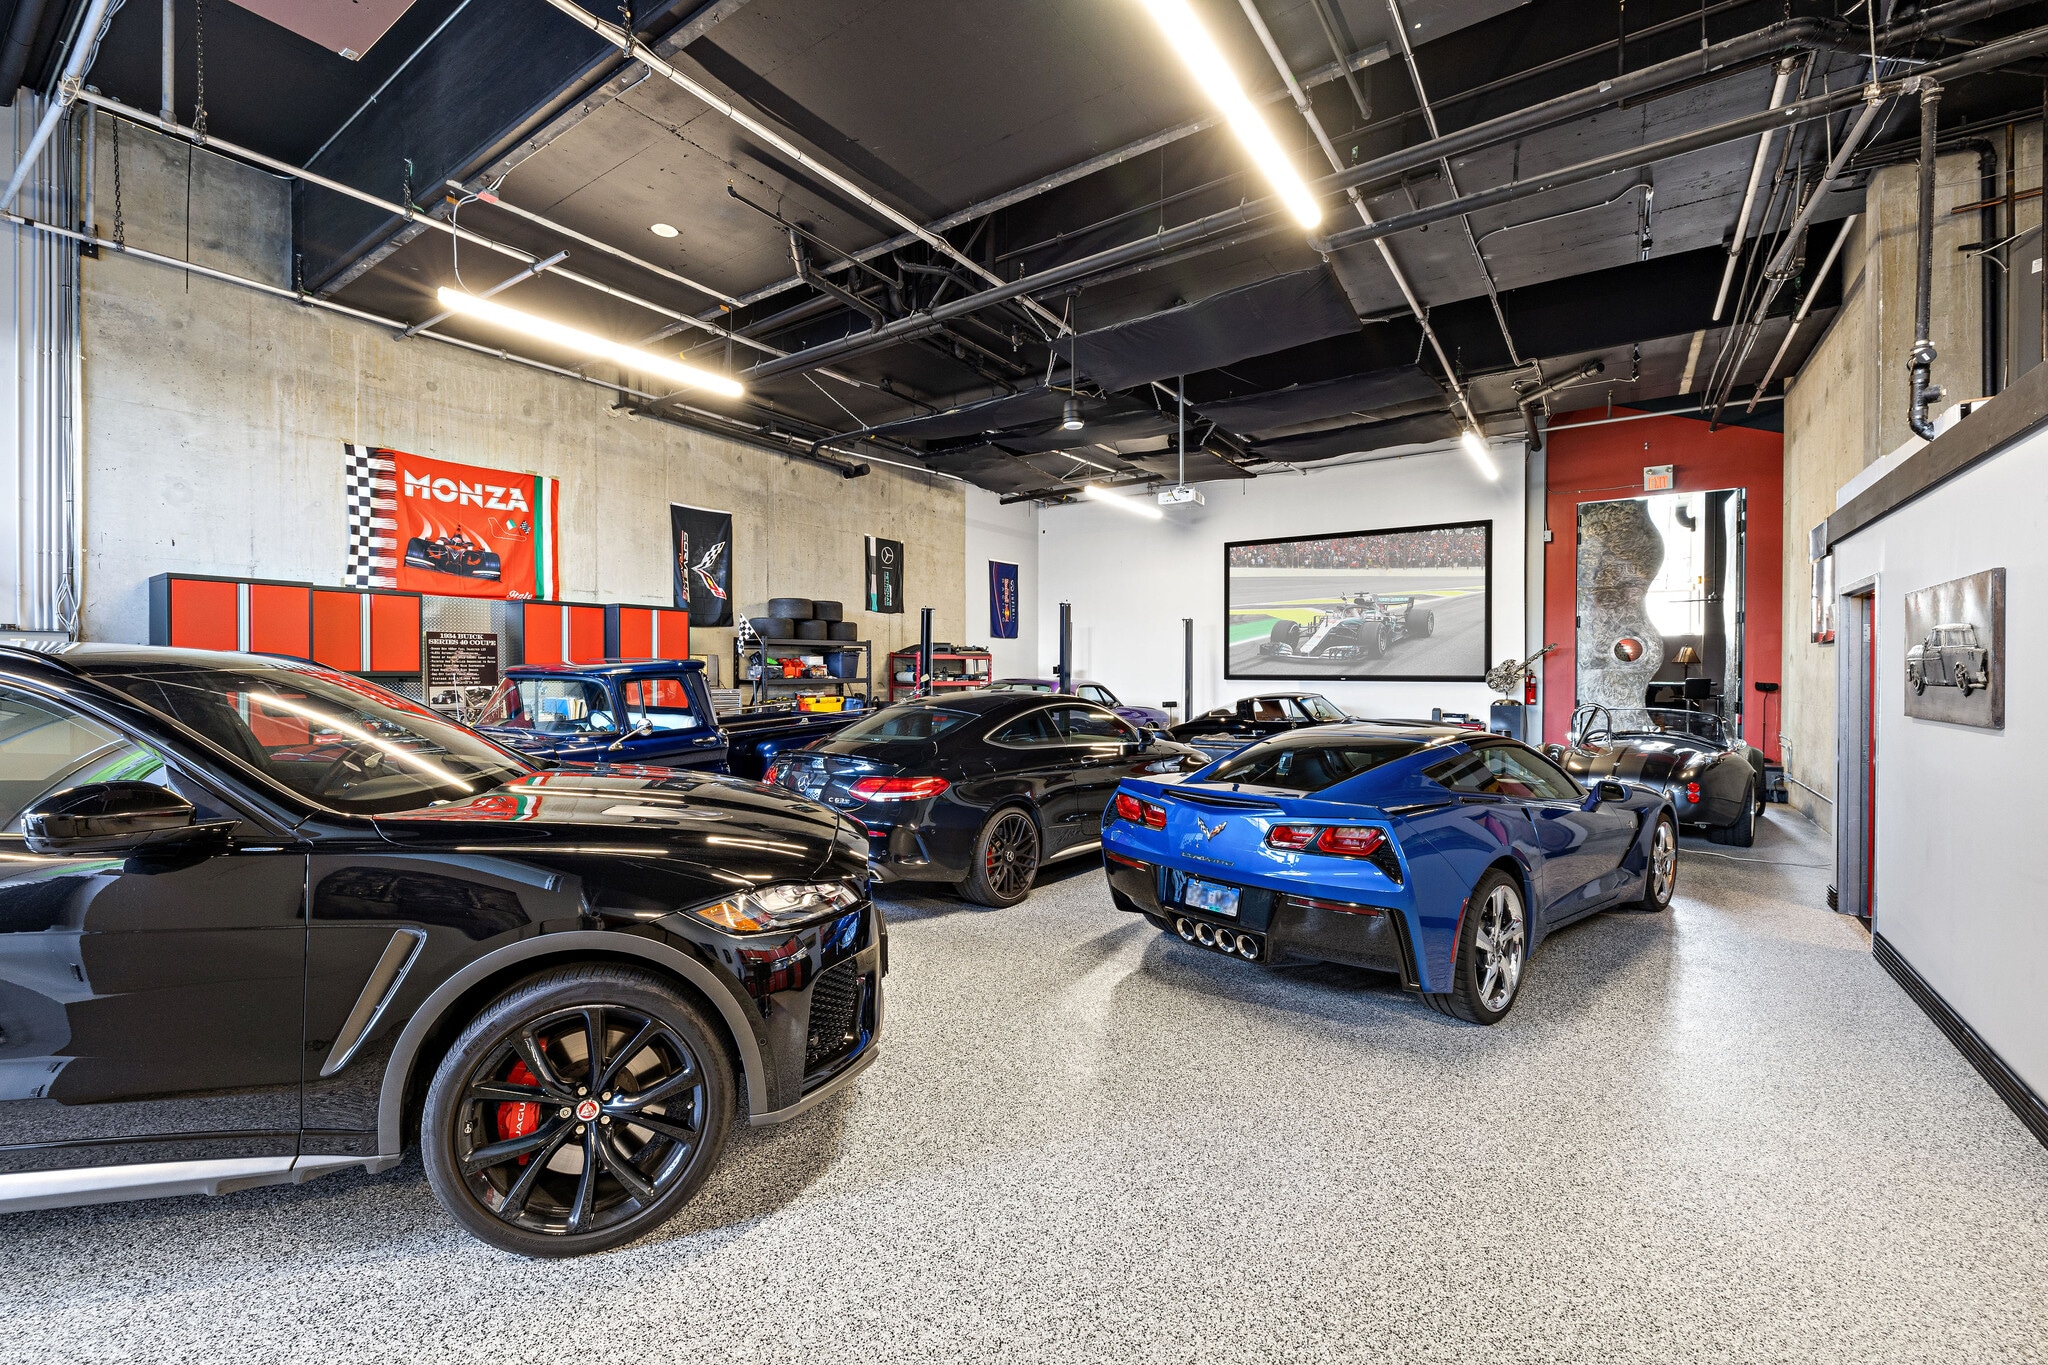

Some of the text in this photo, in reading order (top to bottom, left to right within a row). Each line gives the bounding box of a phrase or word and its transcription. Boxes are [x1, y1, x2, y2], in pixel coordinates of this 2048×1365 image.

[404, 469, 530, 513] MONZA
[1648, 475, 1668, 489] EXIT
[514, 1102, 527, 1137] JAGU
